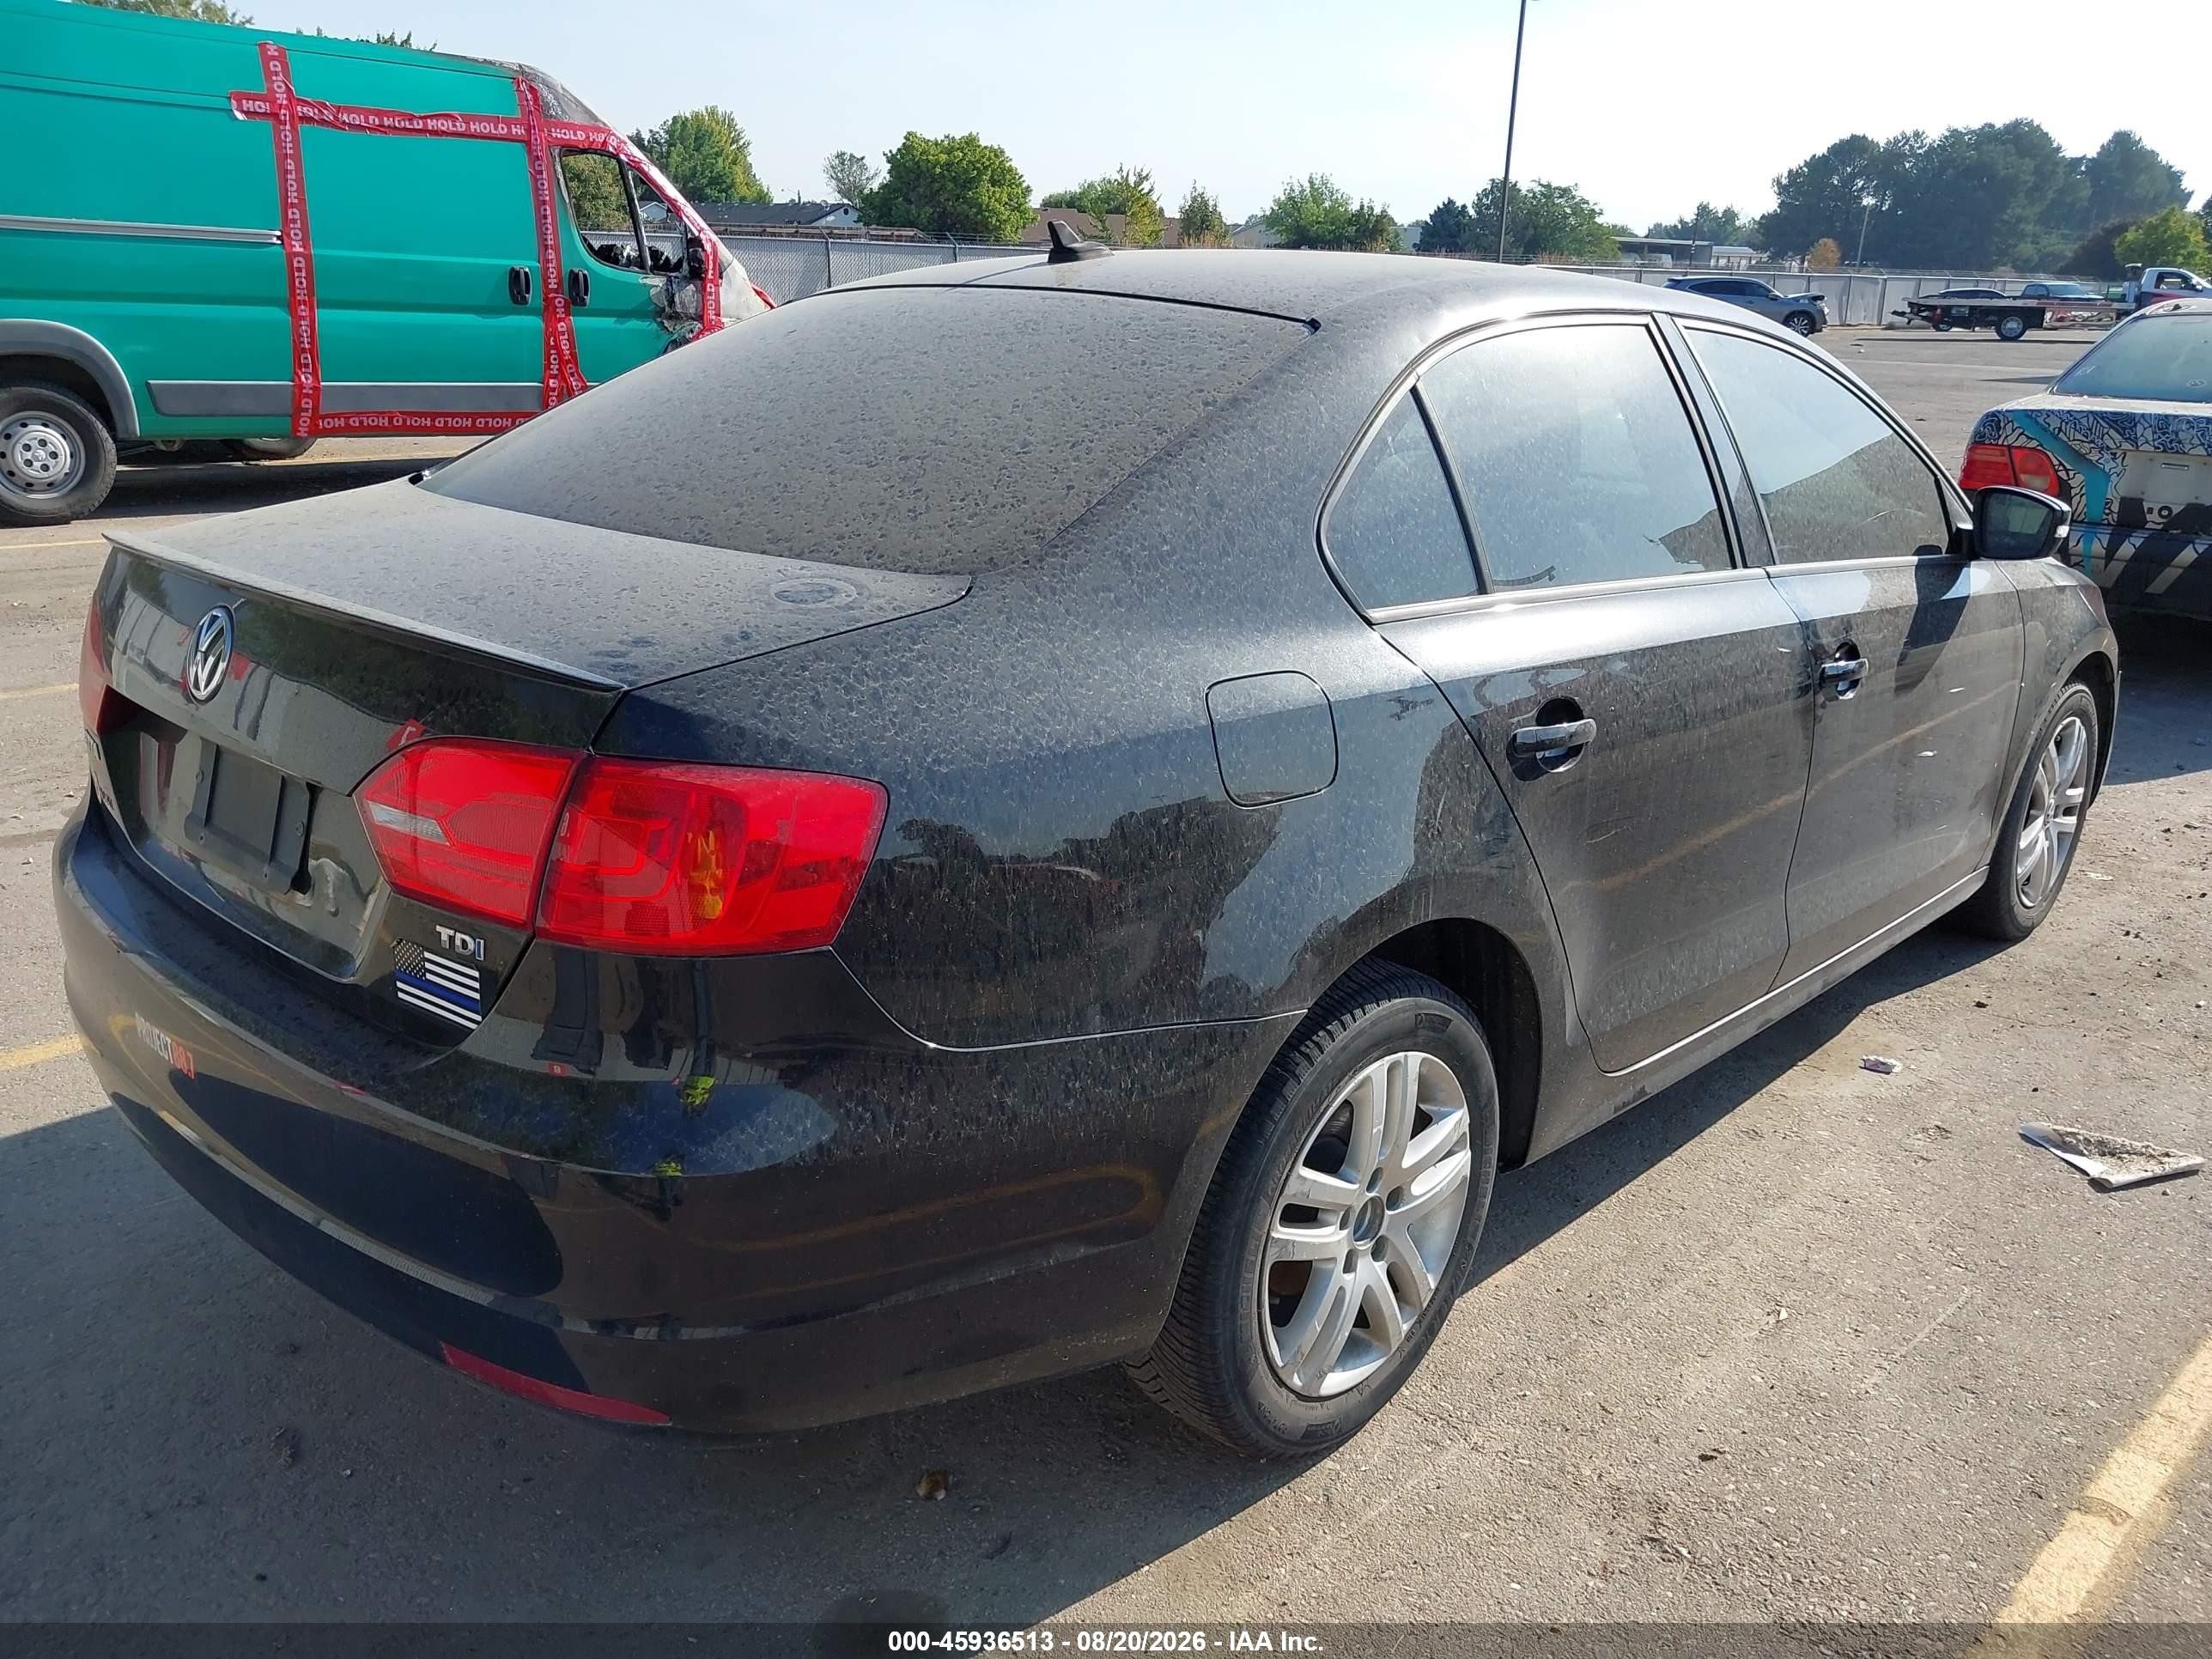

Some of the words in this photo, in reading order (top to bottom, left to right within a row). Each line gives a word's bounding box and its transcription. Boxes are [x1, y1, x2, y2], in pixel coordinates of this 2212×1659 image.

[242, 99, 270, 113] HO
[383, 116, 424, 130] HOLD
[428, 118, 466, 131] HOLD
[470, 121, 507, 135] HOLD
[550, 128, 586, 141] HOLD
[284, 160, 298, 203] HOLD
[534, 160, 550, 200] HOLD
[288, 209, 304, 252] HOLD
[293, 257, 307, 301] HOLD
[545, 249, 557, 289] HOLD
[555, 297, 565, 318] HO
[301, 352, 313, 393] HOLD
[548, 379, 558, 408] OLD
[296, 398, 313, 438] HOLD
[349, 416, 388, 426] HOLD
[393, 417, 429, 427] HOLD
[434, 417, 472, 428] HOLD
[476, 417, 512, 428] HOLD
[435, 924, 485, 962] TDI
